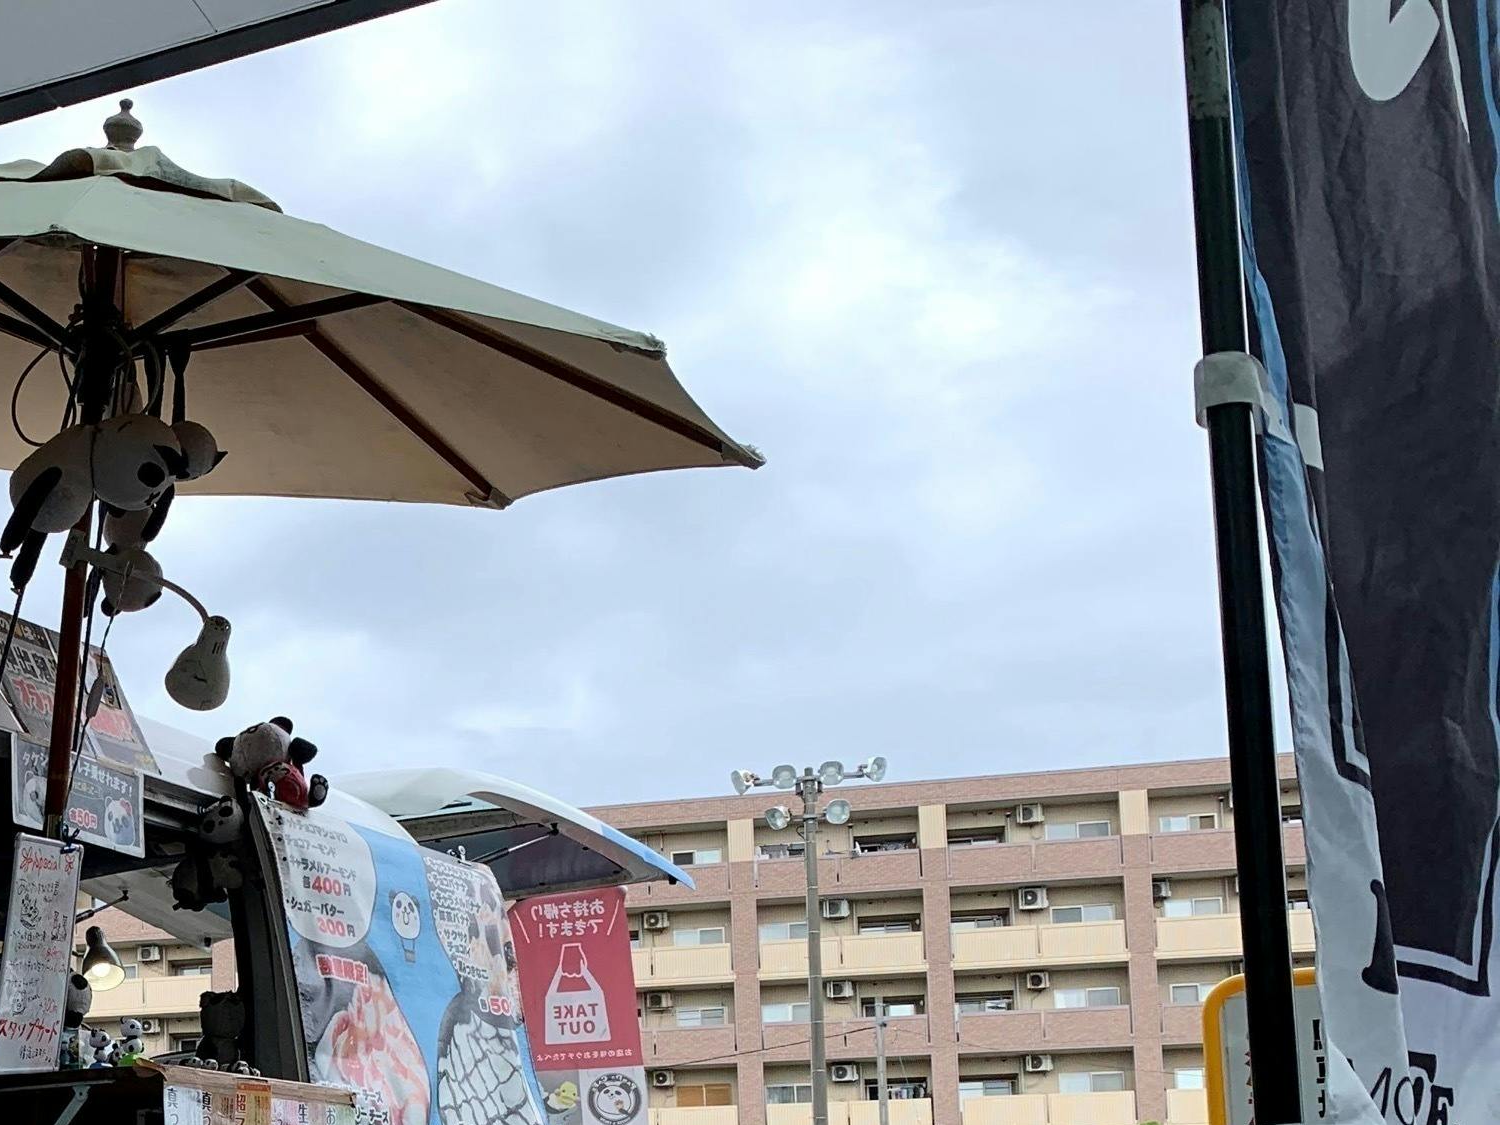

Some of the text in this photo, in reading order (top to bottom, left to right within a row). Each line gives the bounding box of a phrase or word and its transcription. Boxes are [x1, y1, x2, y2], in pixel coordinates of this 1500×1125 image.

[302, 875, 352, 897] 各400円
[290, 896, 345, 918] シュガーバター
